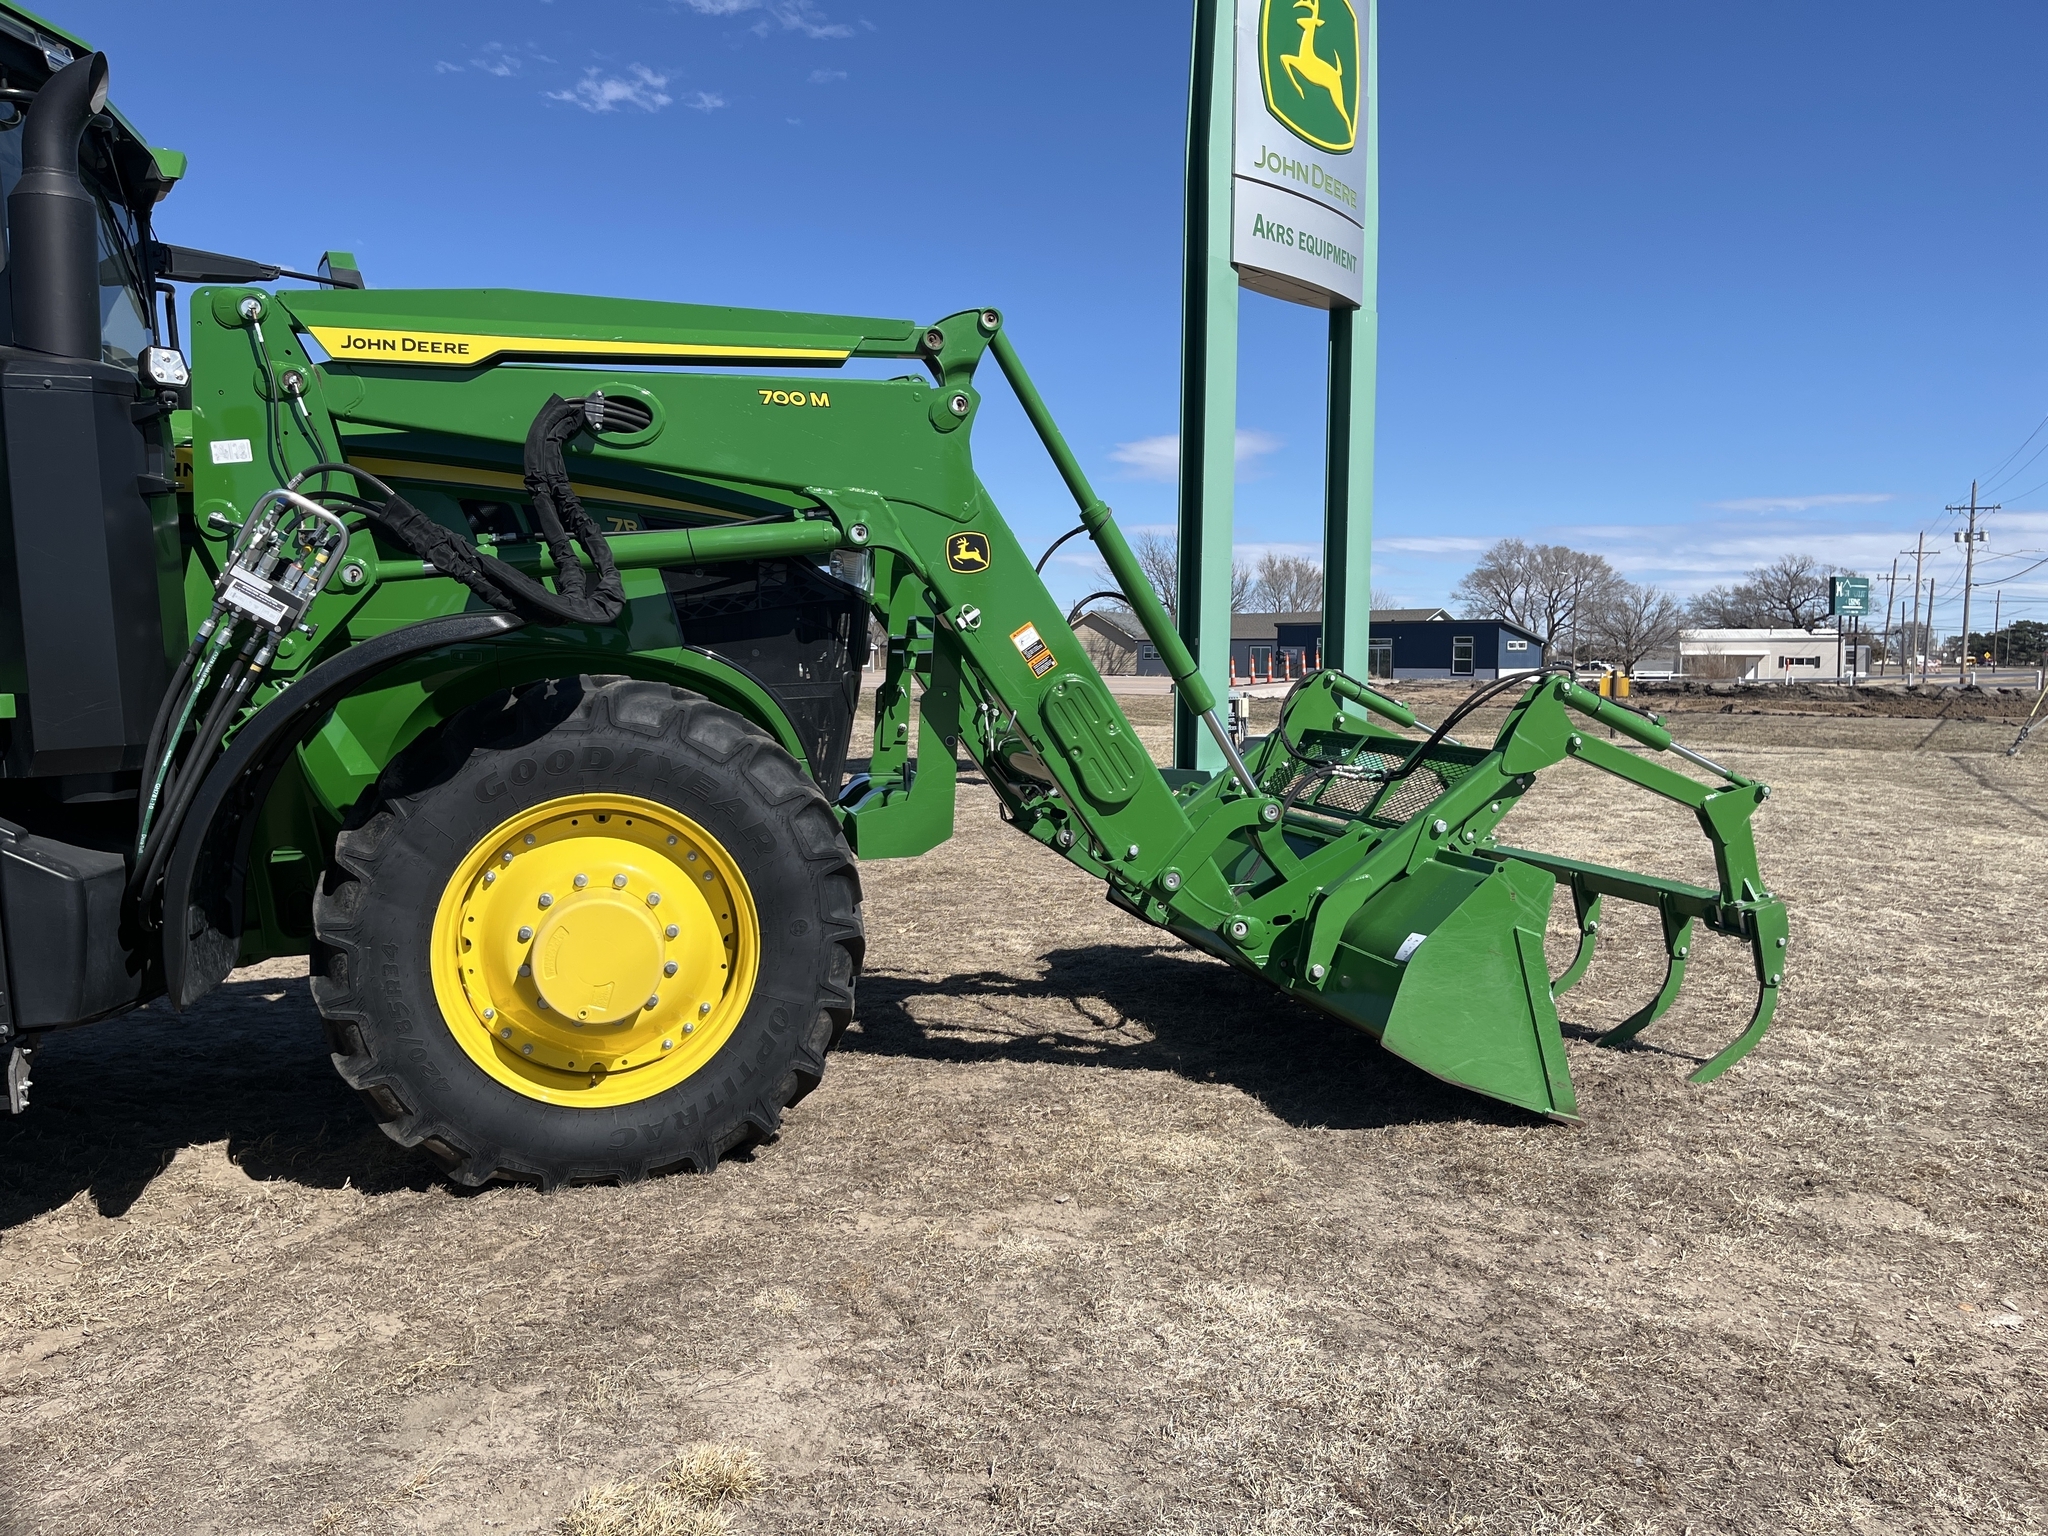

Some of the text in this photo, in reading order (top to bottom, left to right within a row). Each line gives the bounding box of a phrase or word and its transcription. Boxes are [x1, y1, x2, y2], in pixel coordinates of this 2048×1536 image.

[1253, 144, 1358, 211] JOHN DEERE
[1252, 212, 1358, 275] AKRS EQUIPMENT
[340, 334, 470, 355] JOHN DEERE
[757, 388, 832, 409] 700 M
[605, 515, 639, 532] 7R
[474, 745, 778, 857] GOODYEAR
[607, 1004, 791, 1151] OPTITRAC
